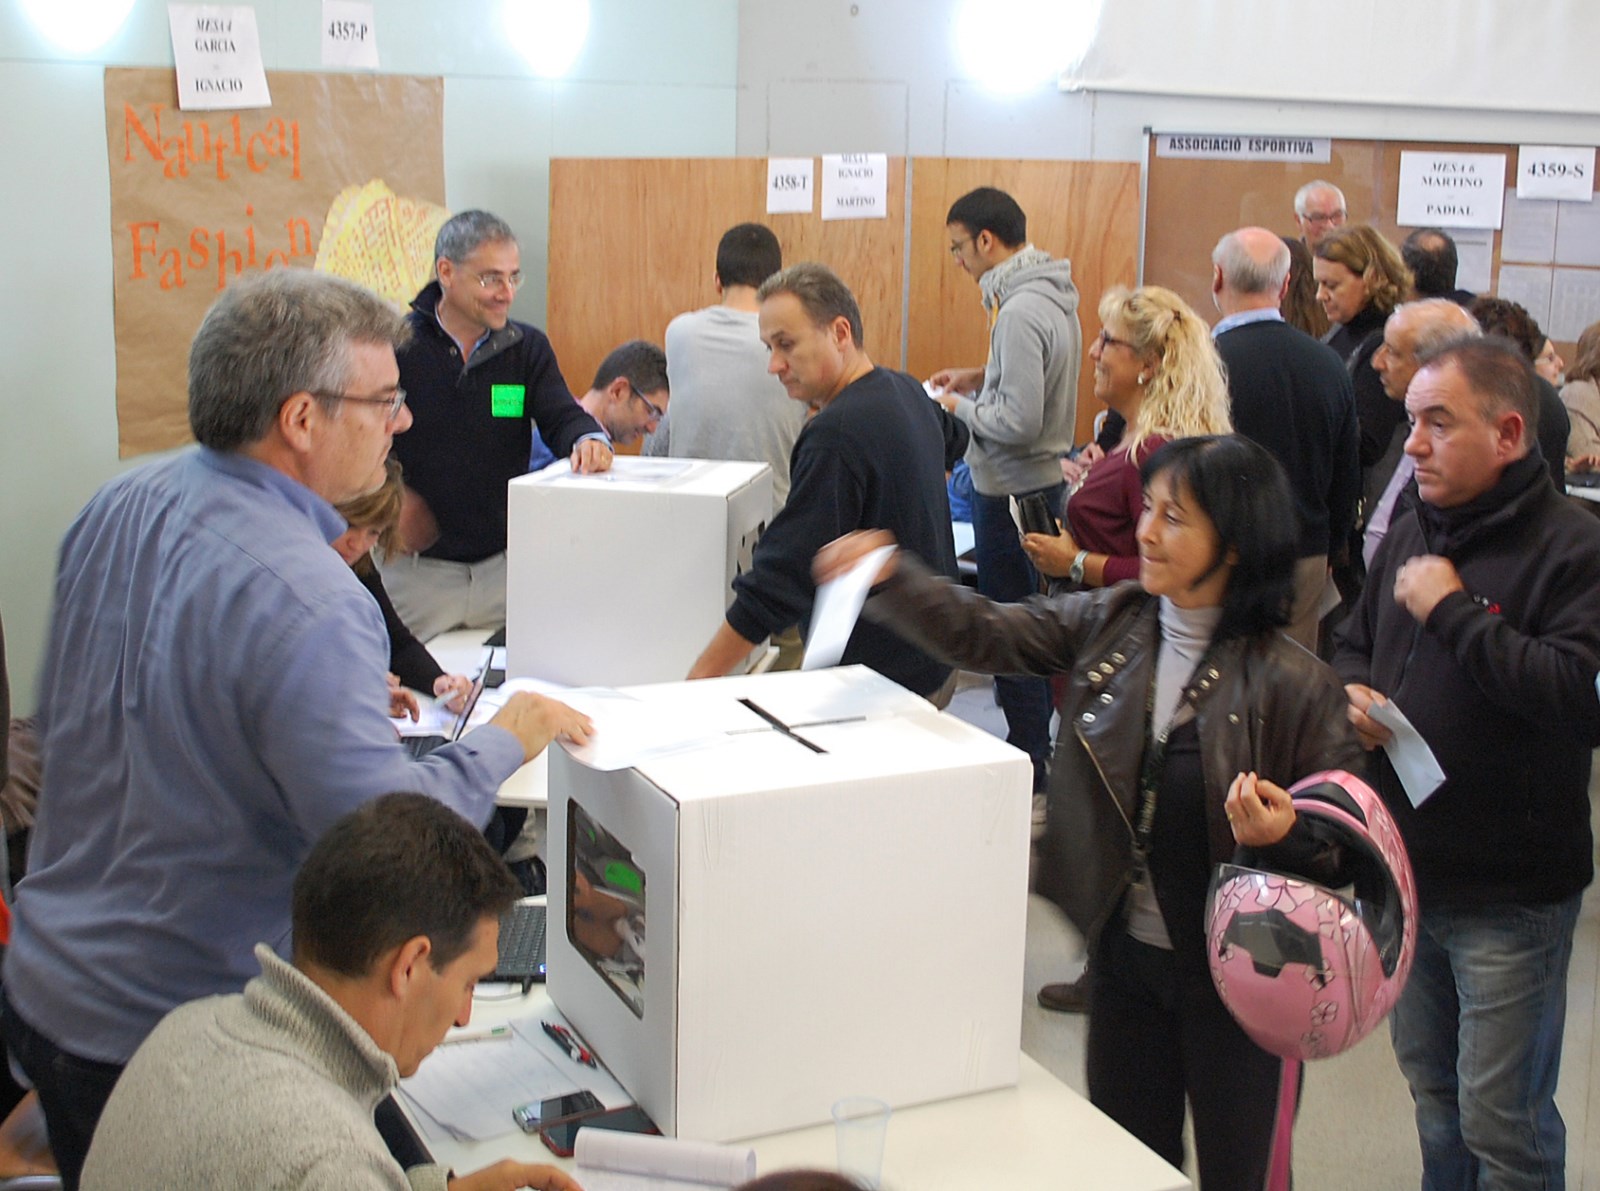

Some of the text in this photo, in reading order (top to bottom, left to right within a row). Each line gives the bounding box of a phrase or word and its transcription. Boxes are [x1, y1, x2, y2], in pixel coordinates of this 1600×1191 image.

[328, 20, 368, 41] 4357-P
[194, 39, 236, 52] GARCIA
[195, 79, 243, 92] IGNACIO
[123, 102, 304, 181] Nautical
[1248, 138, 1314, 154] ESPORTIVA
[838, 168, 873, 178] IGNACIO
[1430, 161, 1466, 173] MESA
[1528, 162, 1584, 179] 4359-S
[772, 174, 807, 190] 4358-T
[1421, 175, 1483, 188] MARTINO
[836, 197, 876, 207] MARTINO
[1425, 204, 1474, 217] PADIAL
